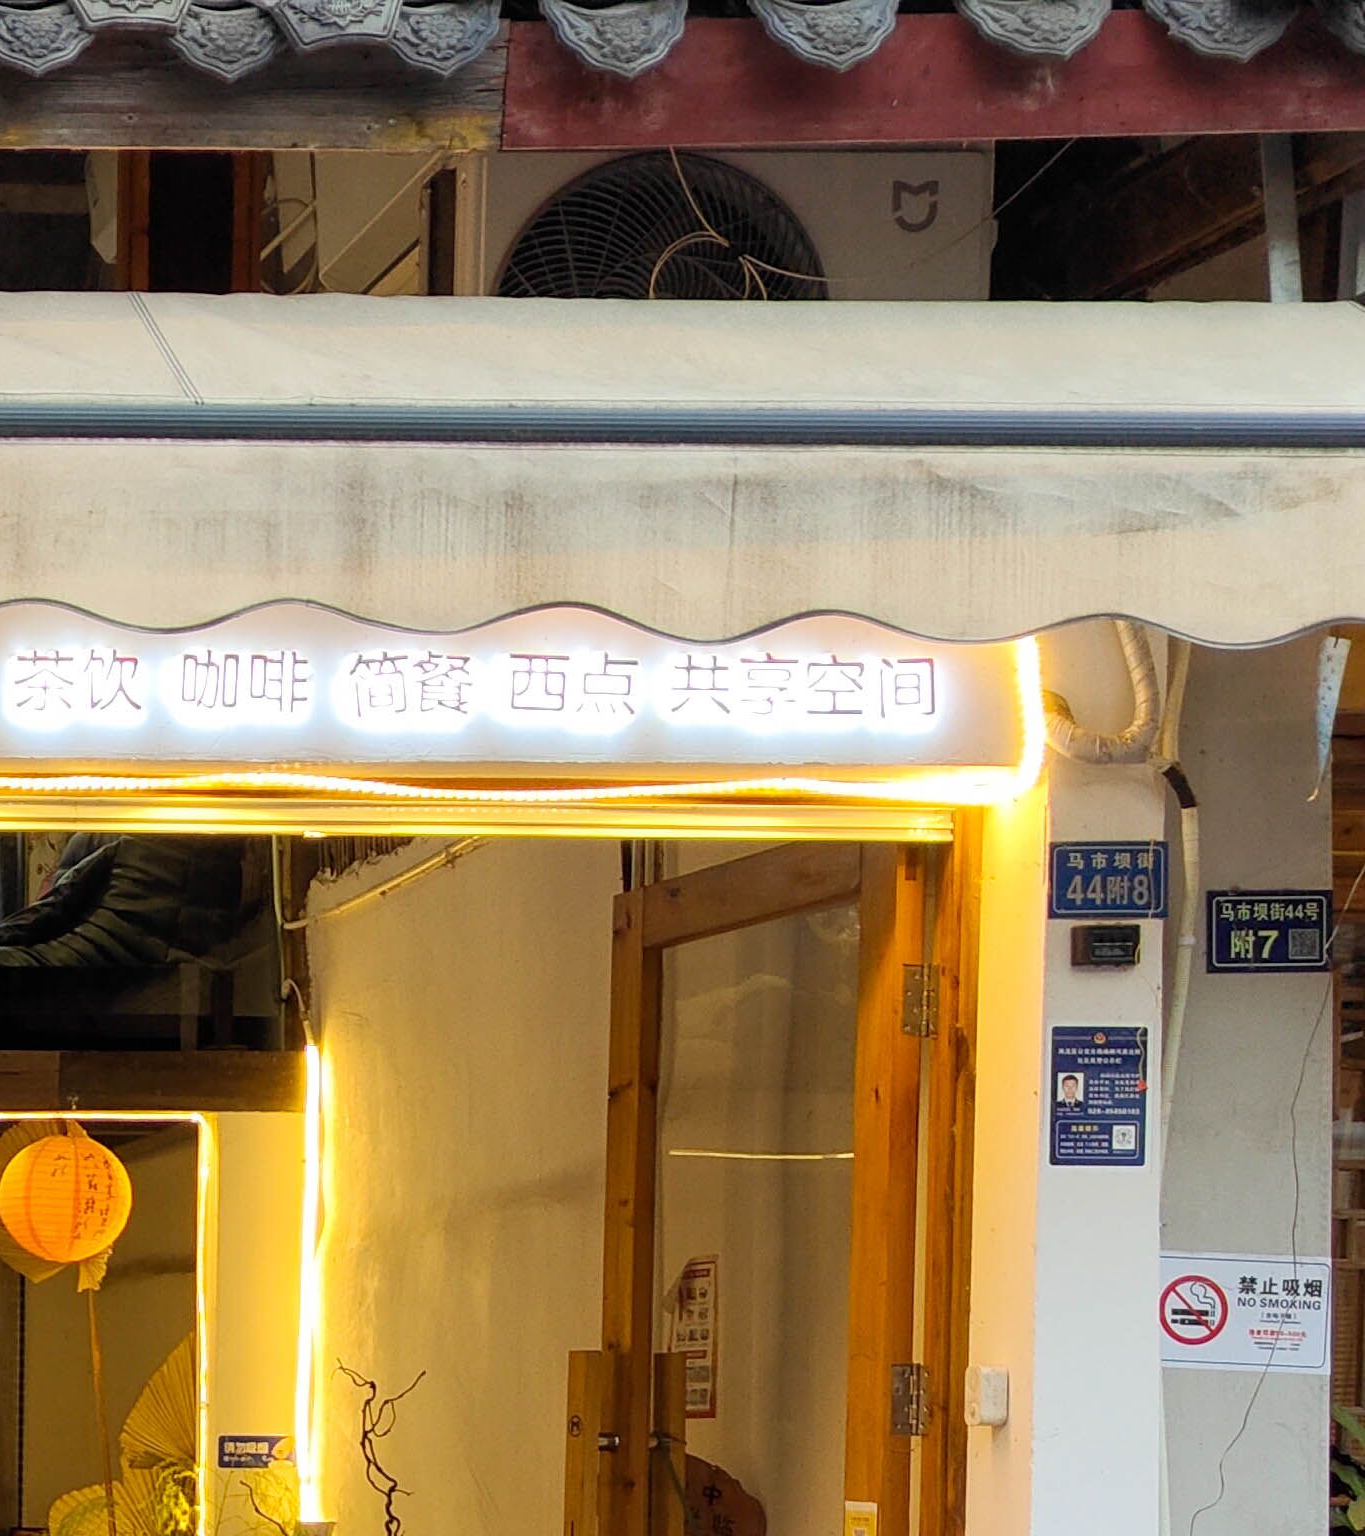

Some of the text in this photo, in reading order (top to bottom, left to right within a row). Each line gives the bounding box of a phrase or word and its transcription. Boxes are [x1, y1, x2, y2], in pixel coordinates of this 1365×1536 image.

[15, 649, 937, 719] 茶饮 咖啡 简餐 西点 共享空间
[1066, 851, 1155, 870] 马市坝街
[1066, 874, 1151, 906] 44附8
[1220, 902, 1320, 922] 马市坝街44号
[1230, 929, 1280, 960] 附7
[1237, 1275, 1323, 1298] 禁止吸烟
[1237, 1297, 1322, 1311] NO SMOKING
